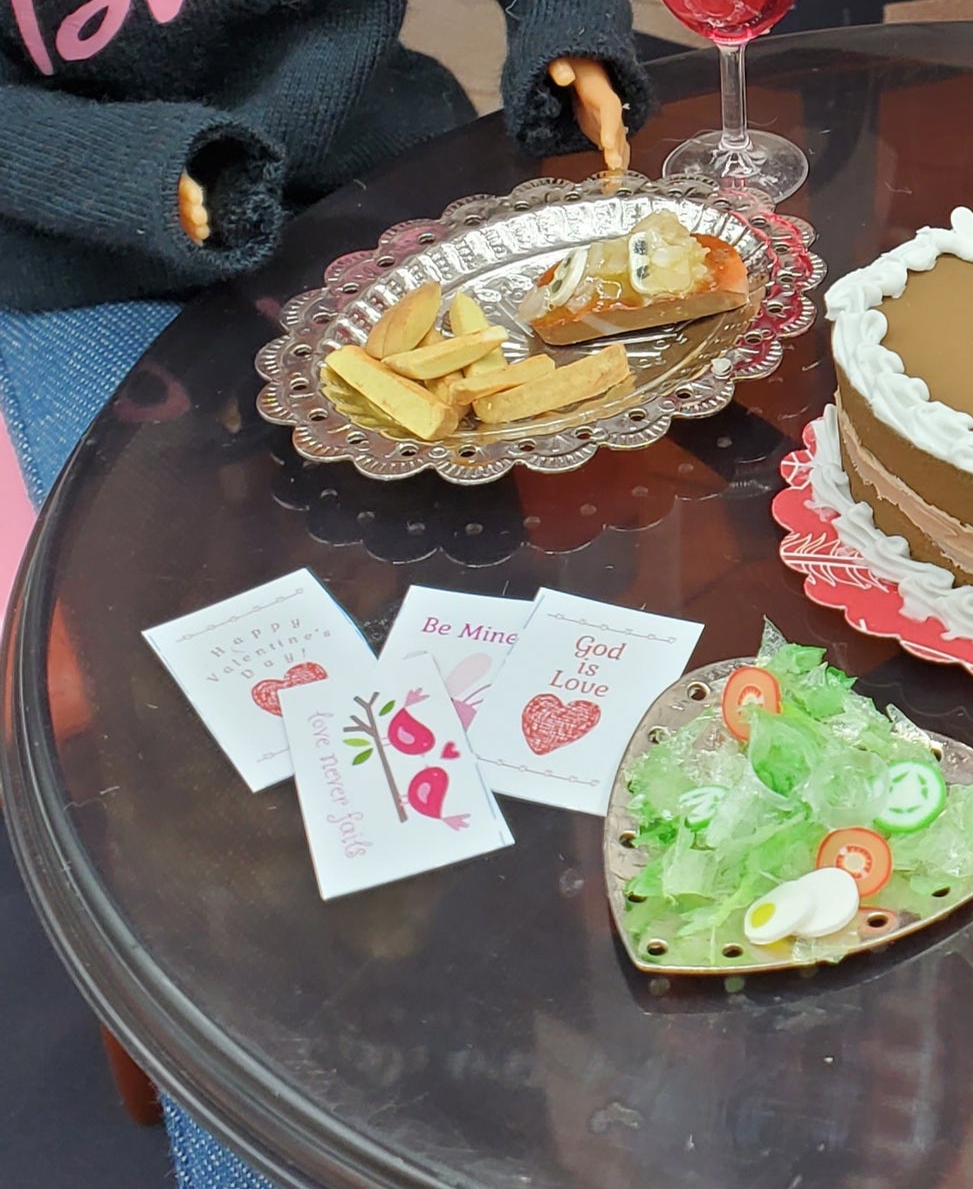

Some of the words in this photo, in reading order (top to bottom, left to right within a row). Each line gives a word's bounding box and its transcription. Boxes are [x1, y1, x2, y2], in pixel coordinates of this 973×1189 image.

[210, 618, 301, 658] Happy
[421, 616, 451, 636] Be
[458, 623, 519, 646] Mine
[206, 628, 331, 683] Valentine's
[241, 648, 307, 680] Day!
[575, 635, 627, 661] God
[549, 669, 610, 698] Love
[577, 658, 599, 677] is
[319, 753, 350, 806] never
[326, 811, 375, 860] fails
